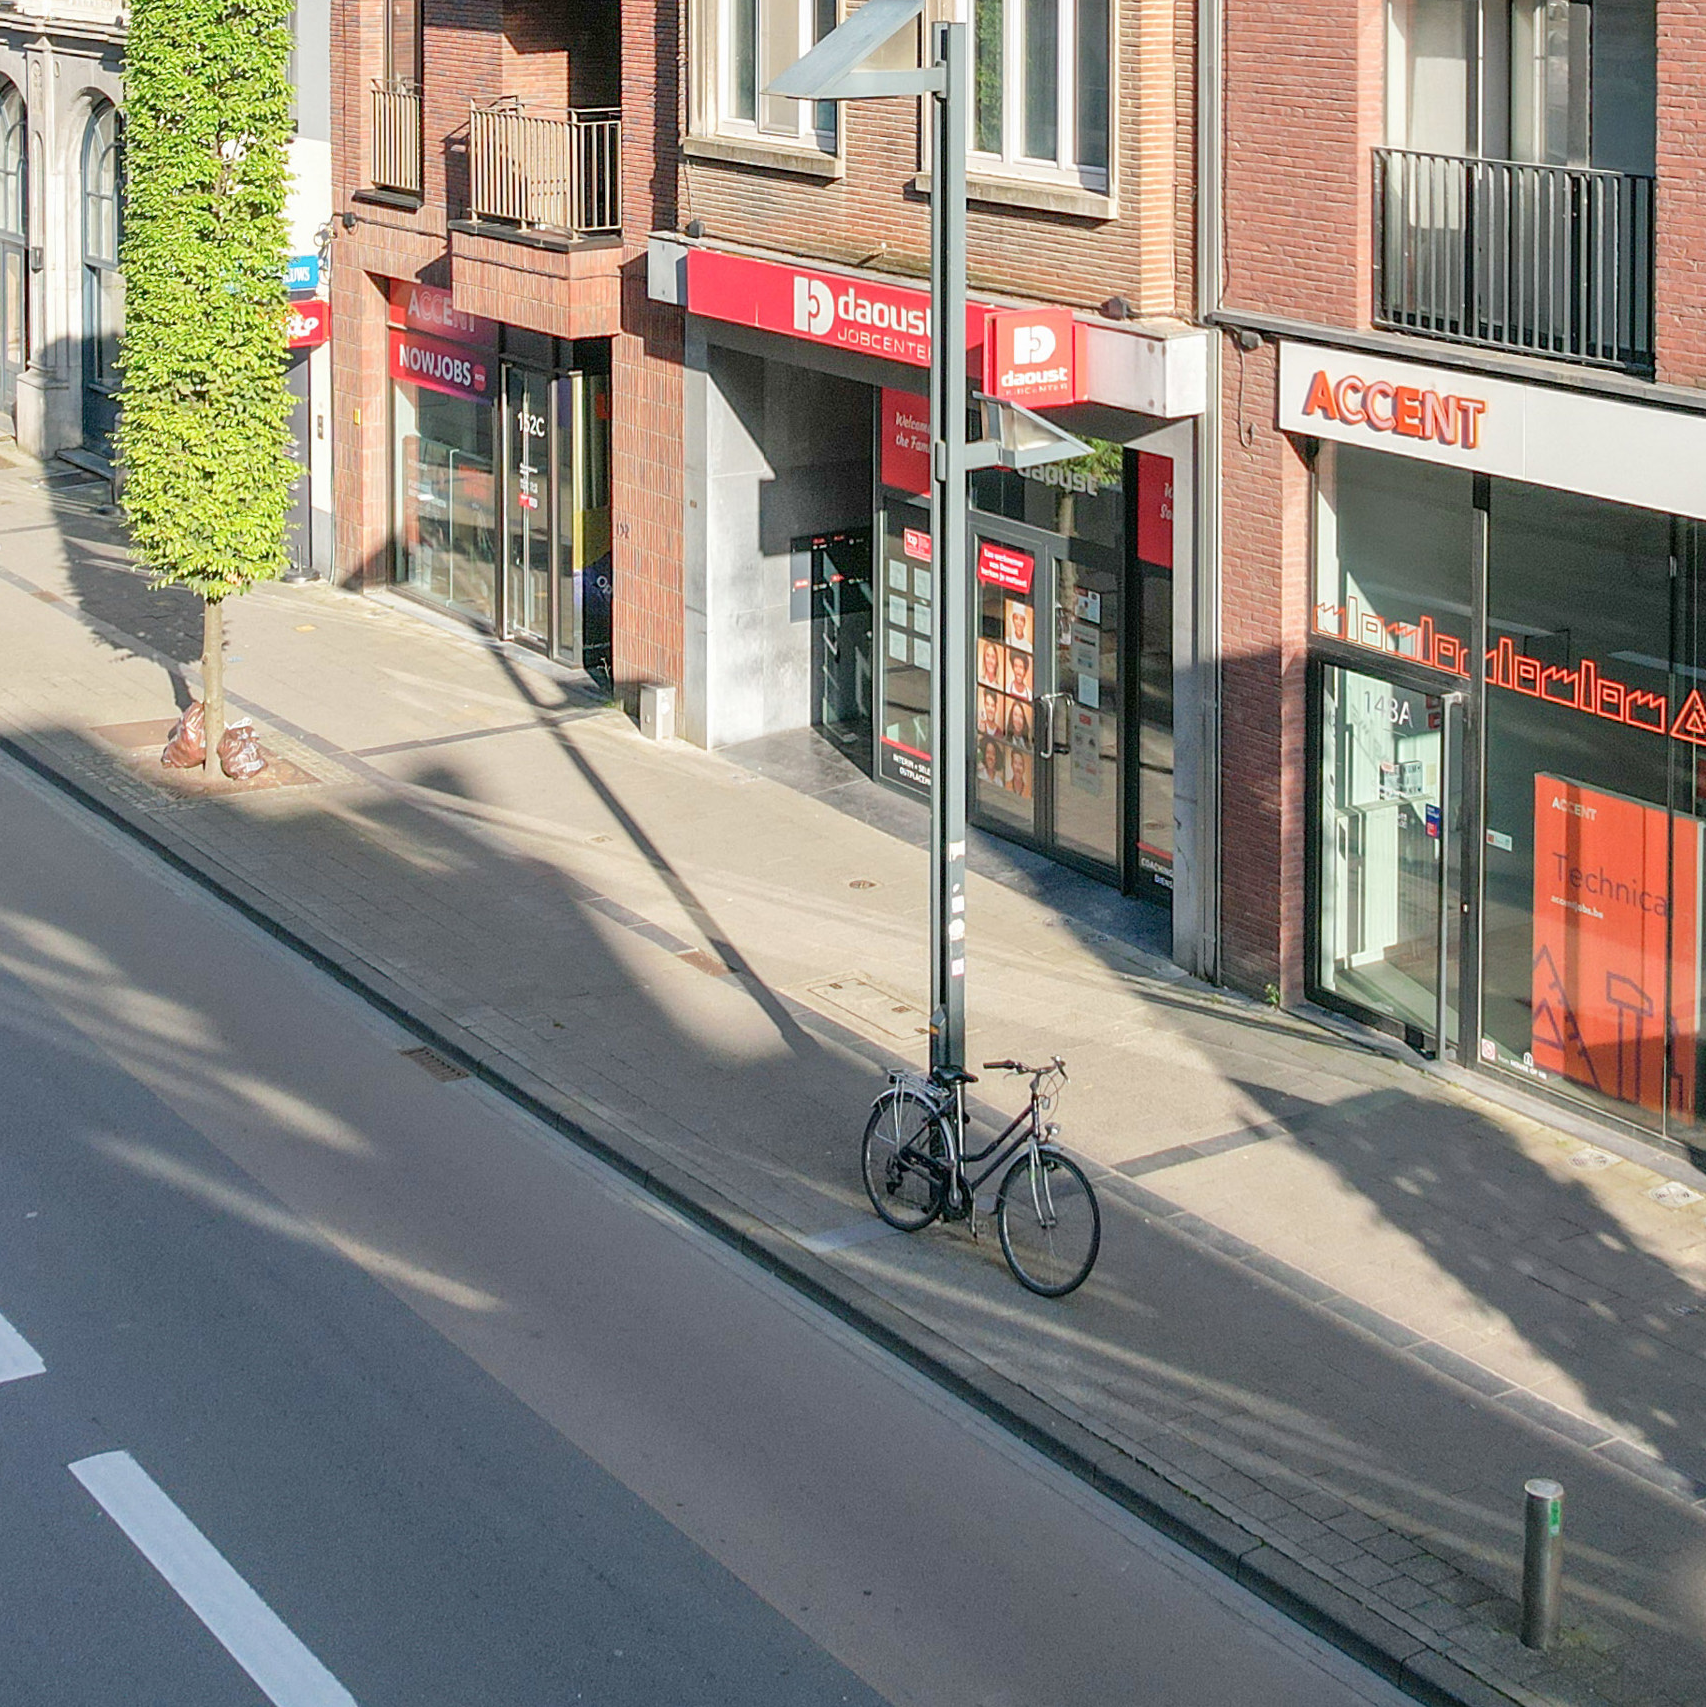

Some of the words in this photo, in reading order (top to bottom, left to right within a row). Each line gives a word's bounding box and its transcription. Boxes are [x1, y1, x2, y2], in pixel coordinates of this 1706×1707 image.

[399, 344, 471, 386] NOWJOBS
[1001, 367, 1068, 387] daoust
[1302, 370, 1486, 449] ACCENT
[518, 412, 545, 437] 152C
[1552, 797, 1597, 821] ACCENT
